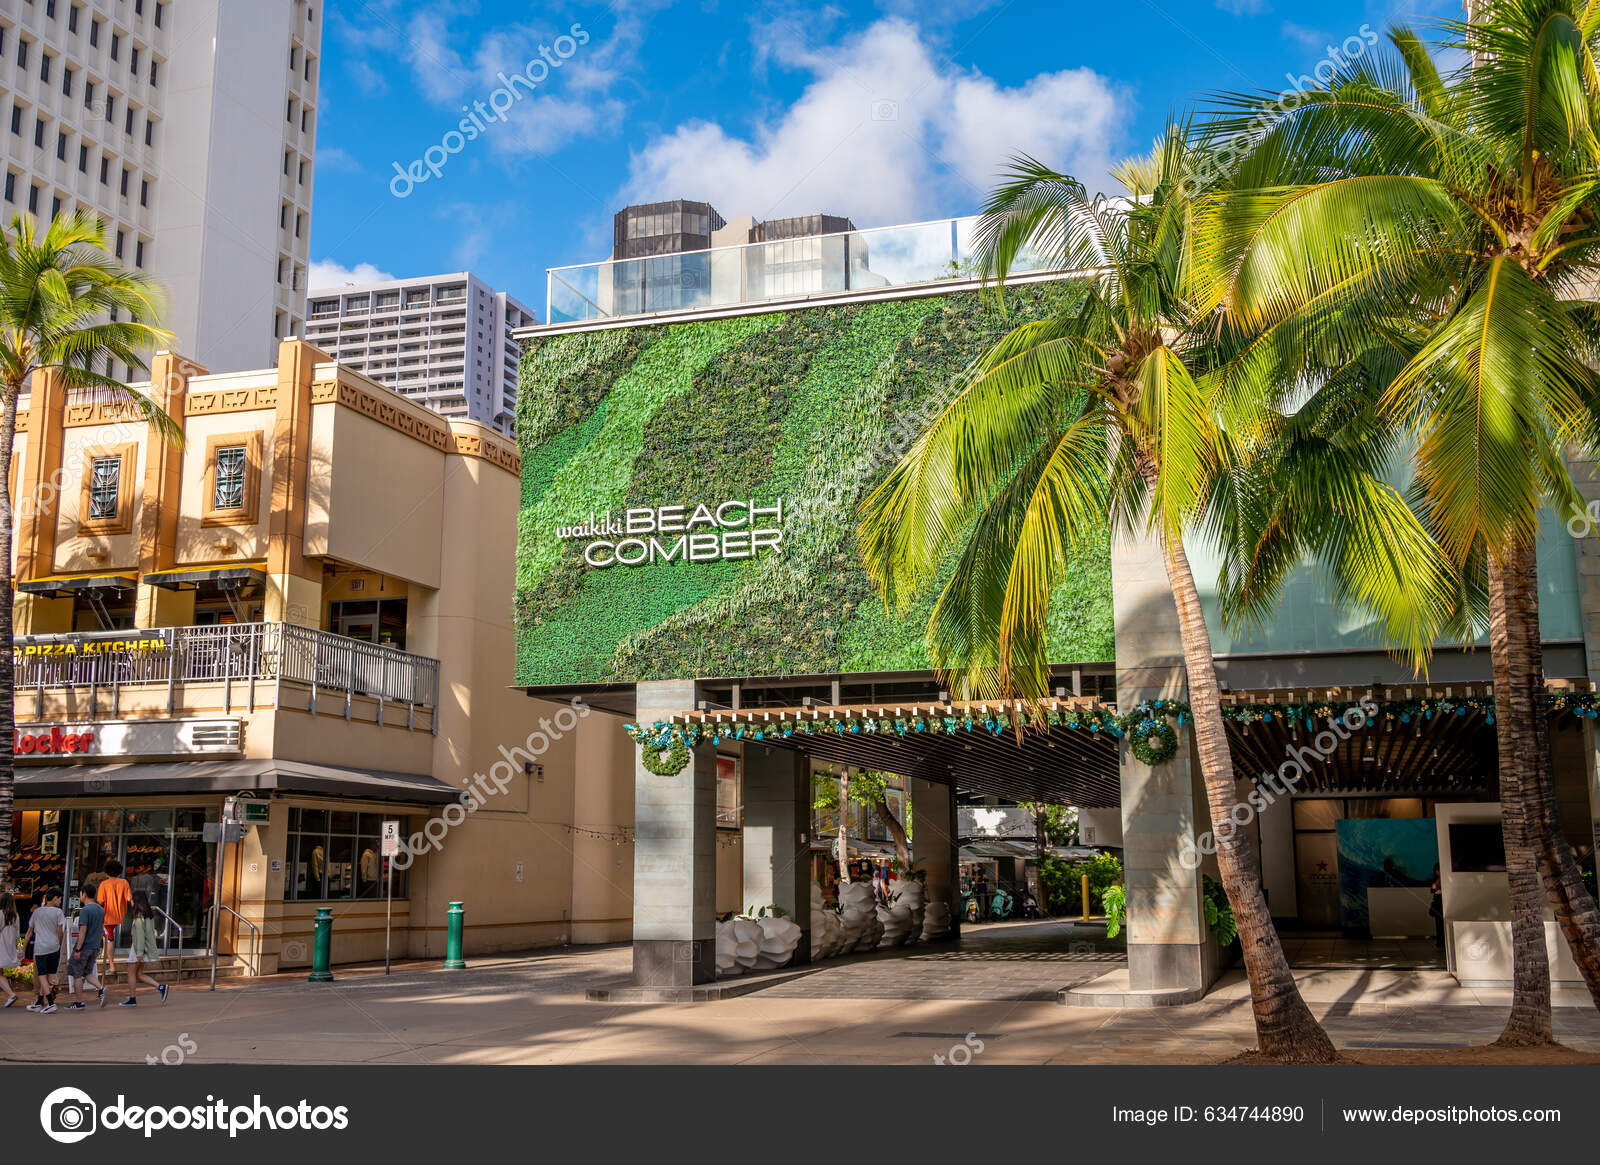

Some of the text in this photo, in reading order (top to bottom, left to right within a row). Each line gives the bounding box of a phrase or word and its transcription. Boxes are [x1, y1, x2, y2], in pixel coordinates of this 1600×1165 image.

[556, 498, 782, 539] waikiki BEACH
[584, 528, 783, 566] COMBER
[25, 643, 77, 656] PIZZA
[83, 638, 165, 654] KITCHEN
[388, 825, 393, 834] 5
